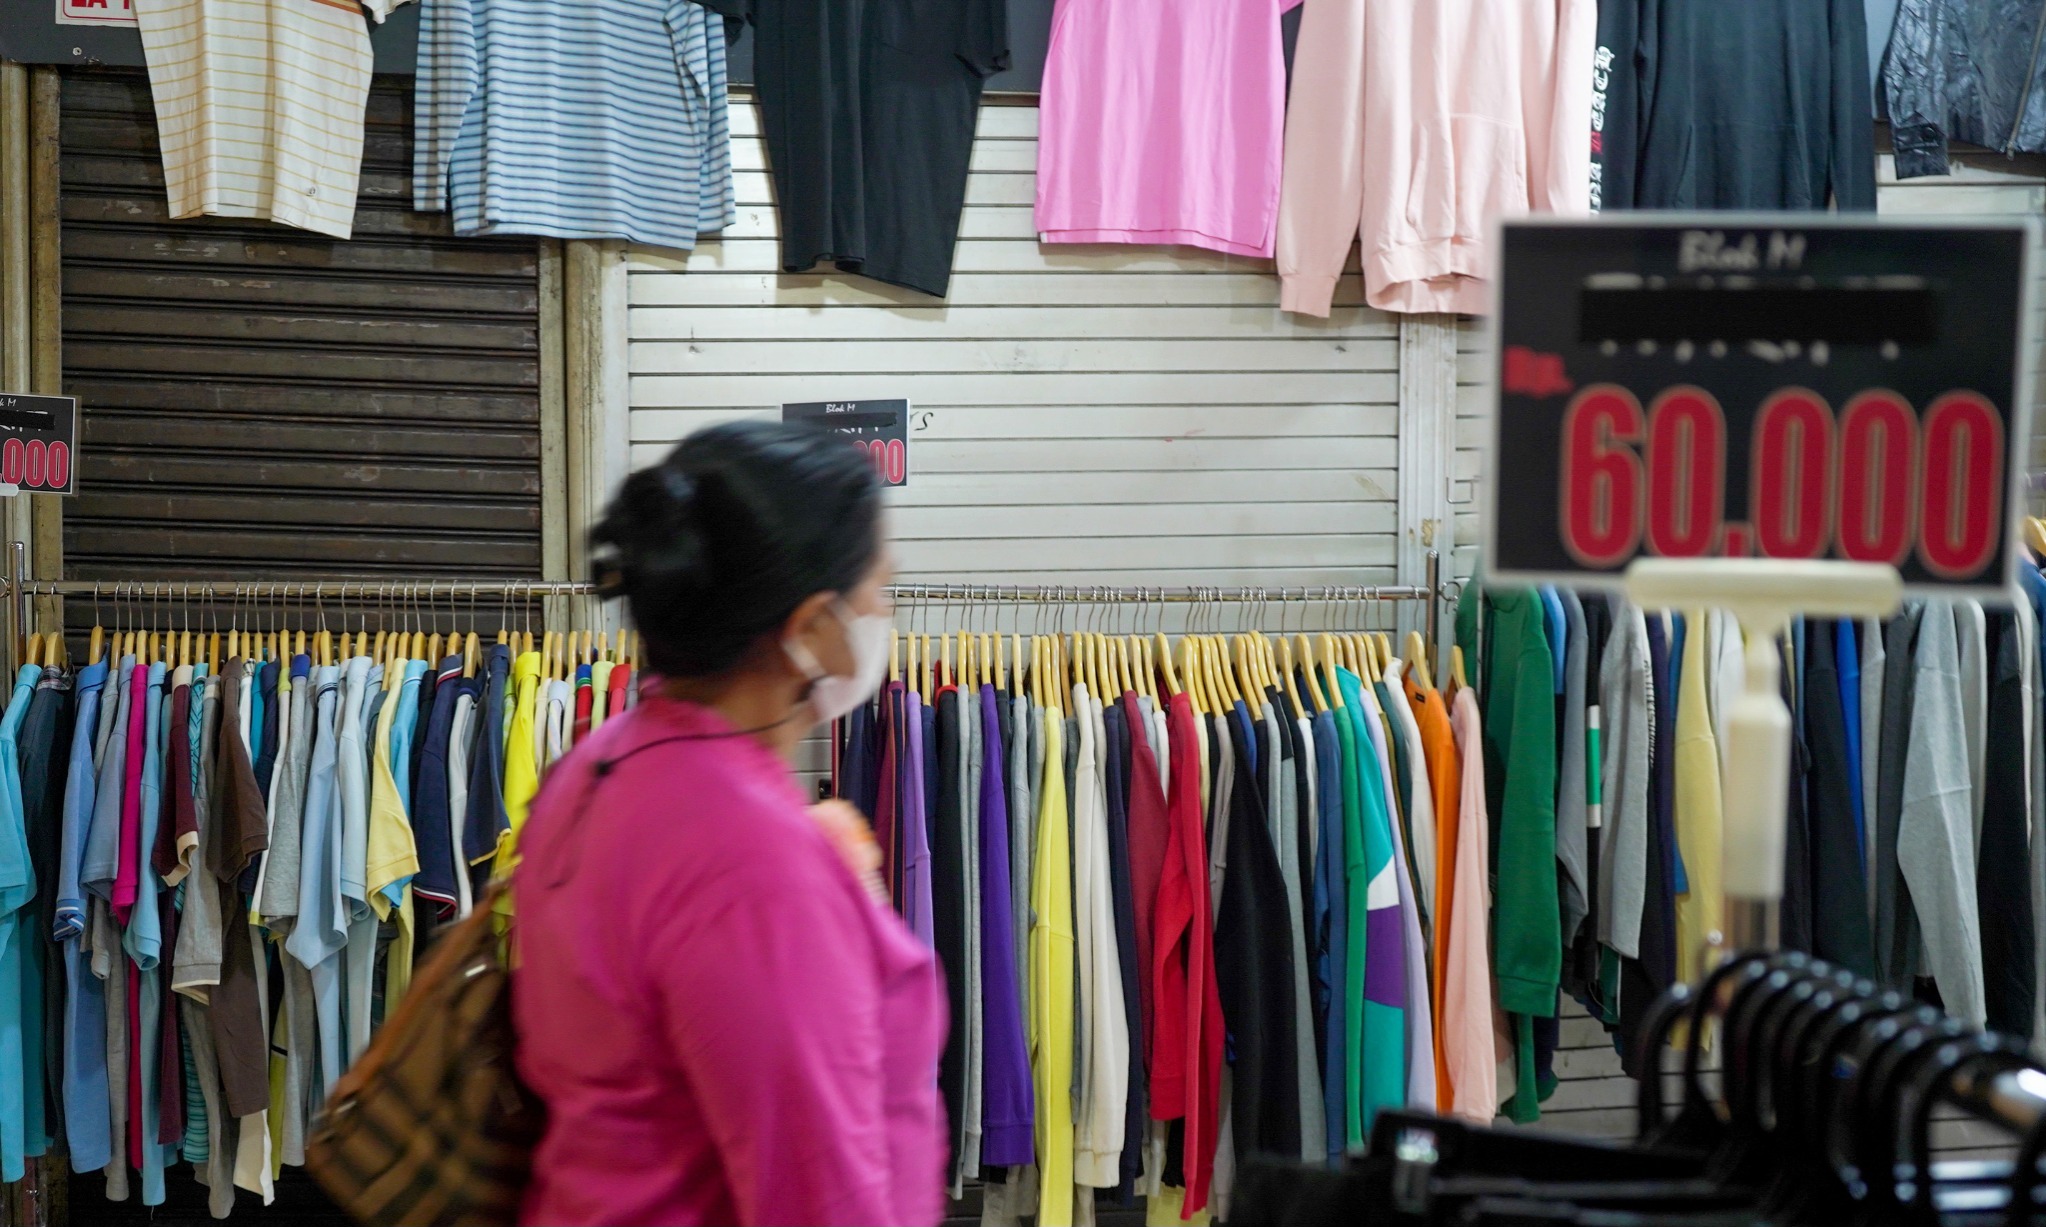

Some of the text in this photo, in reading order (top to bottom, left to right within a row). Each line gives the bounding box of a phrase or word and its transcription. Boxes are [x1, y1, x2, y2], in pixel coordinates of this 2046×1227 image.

[847, 402, 856, 412] M
[852, 438, 905, 484] 00
[1560, 383, 2005, 580] 60.000
